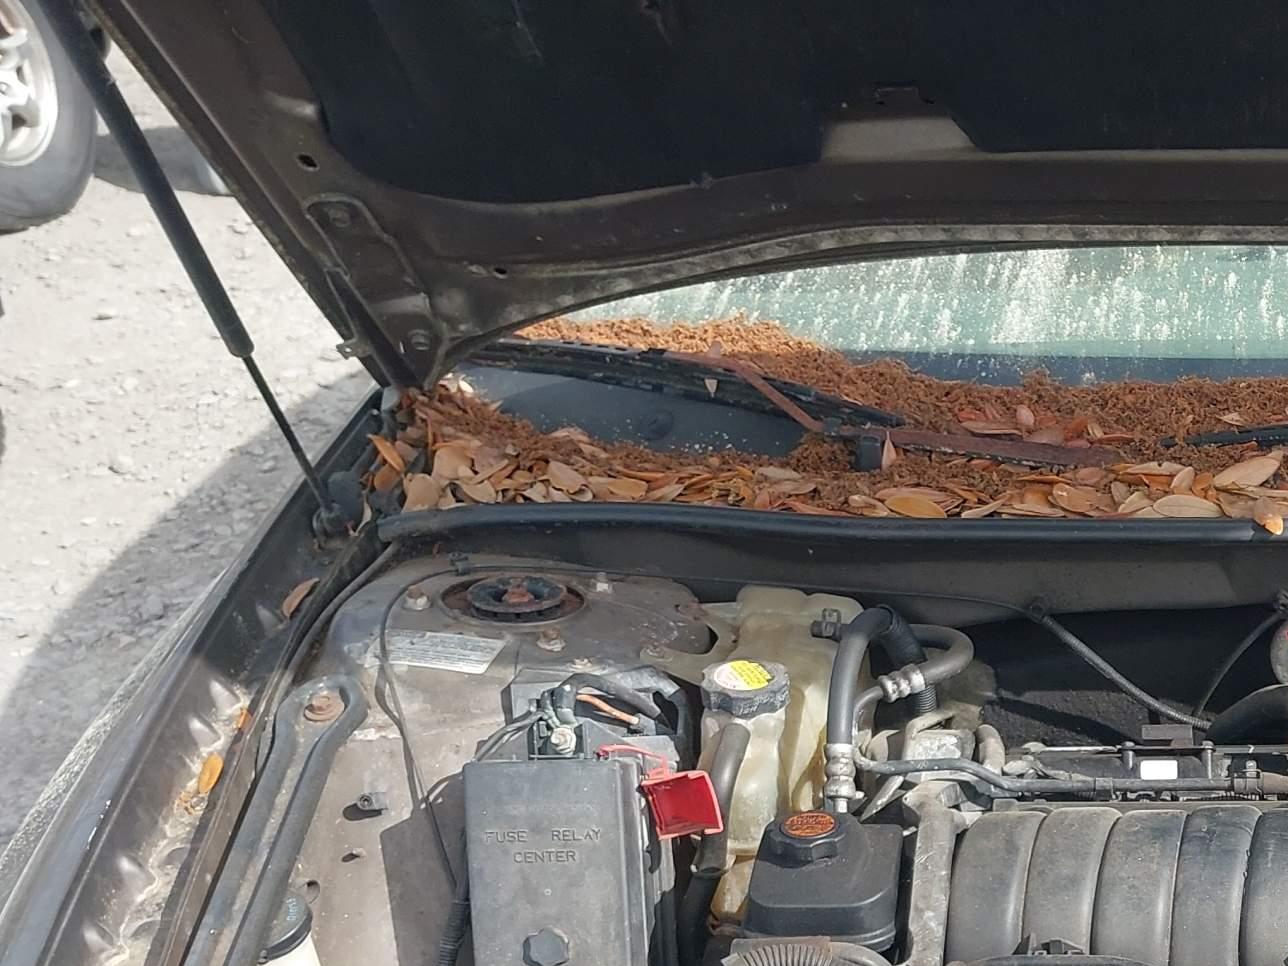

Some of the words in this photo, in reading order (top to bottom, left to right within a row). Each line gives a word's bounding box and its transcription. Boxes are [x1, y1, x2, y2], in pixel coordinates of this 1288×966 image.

[484, 830, 528, 843] FUSE
[551, 828, 601, 842] RELAY
[513, 850, 576, 864] CENTER
